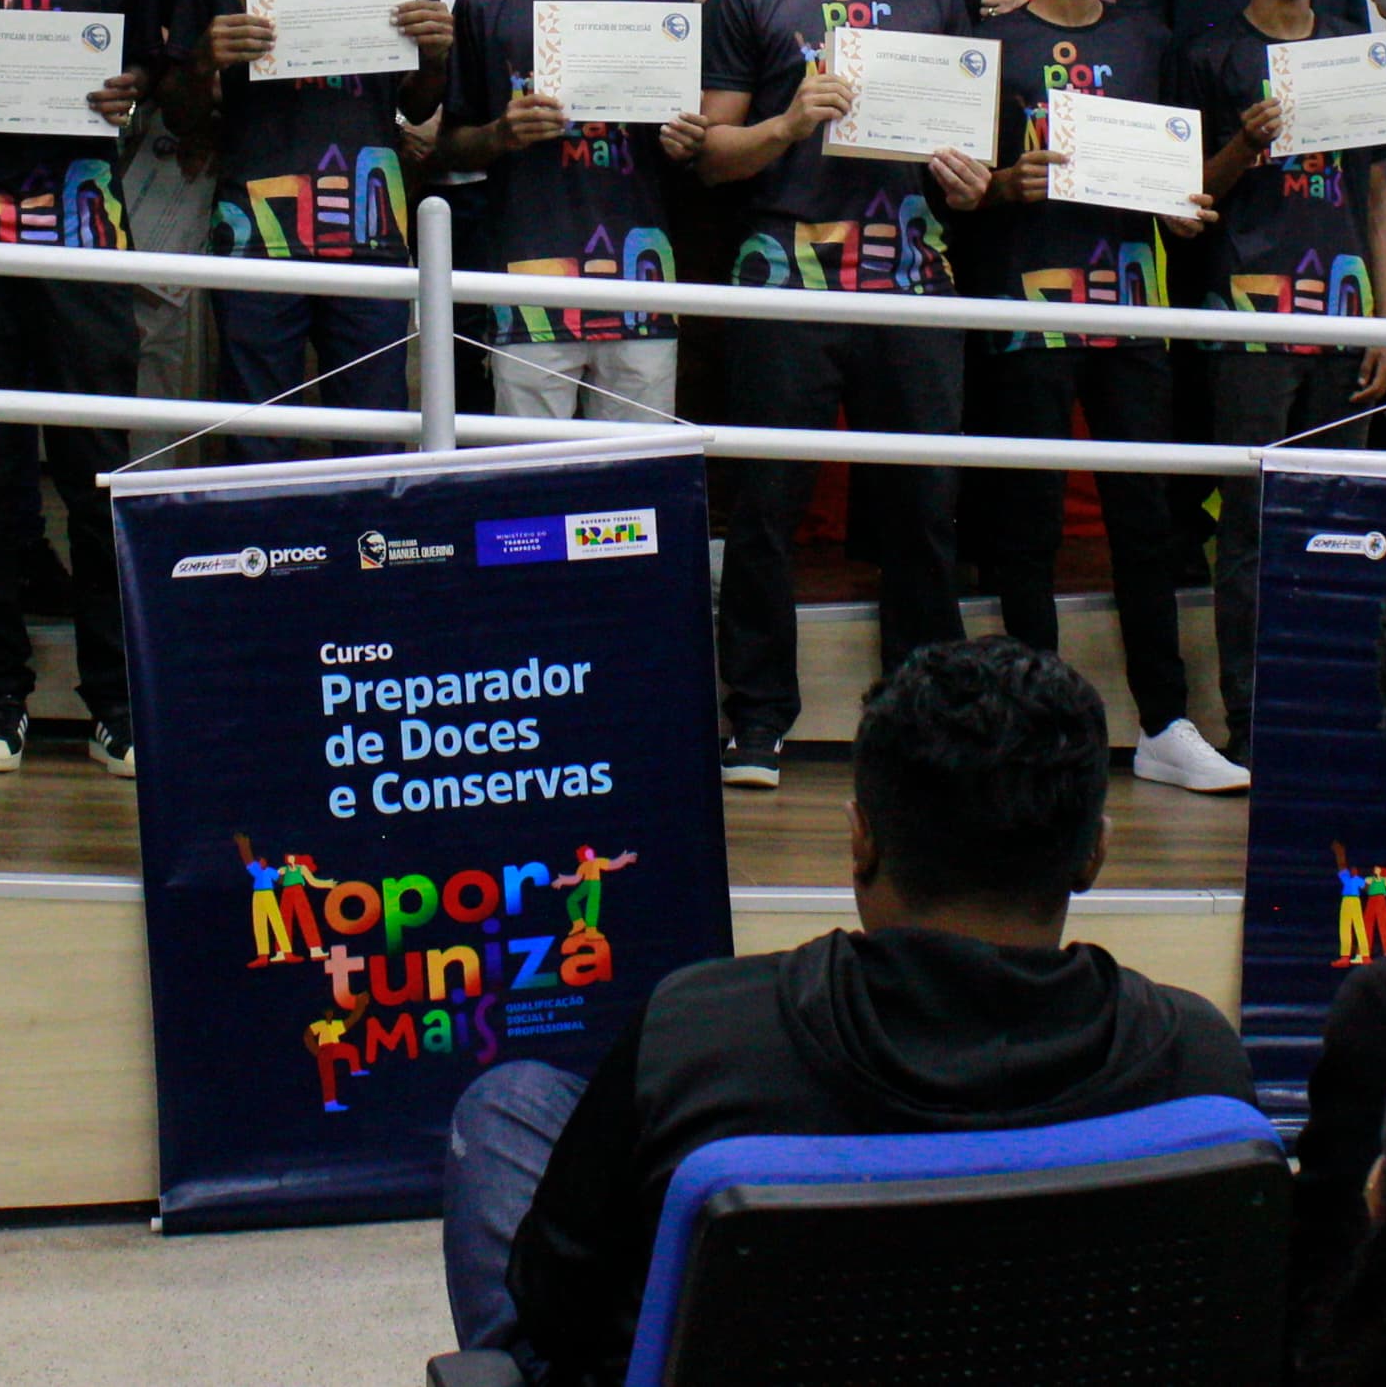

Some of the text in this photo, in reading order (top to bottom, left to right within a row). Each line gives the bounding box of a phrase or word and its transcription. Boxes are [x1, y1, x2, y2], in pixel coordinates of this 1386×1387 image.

[822, 1, 891, 31] por
[1053, 41, 1077, 64] o
[1044, 64, 1112, 90] por
[575, 522, 648, 546] BRASIL
[270, 545, 327, 567] proec
[388, 547, 420, 560] MANUEL
[320, 643, 393, 665] Curso
[321, 657, 591, 715] Preparador
[325, 717, 540, 767] de Doces
[328, 762, 613, 818] e Conservas
[324, 918, 611, 1010] tuniza
[506, 996, 584, 1013] QUALIFICAÇÃO
[507, 1012, 544, 1025] SOCIAL
[507, 1020, 586, 1038] PROFISSIONAL
